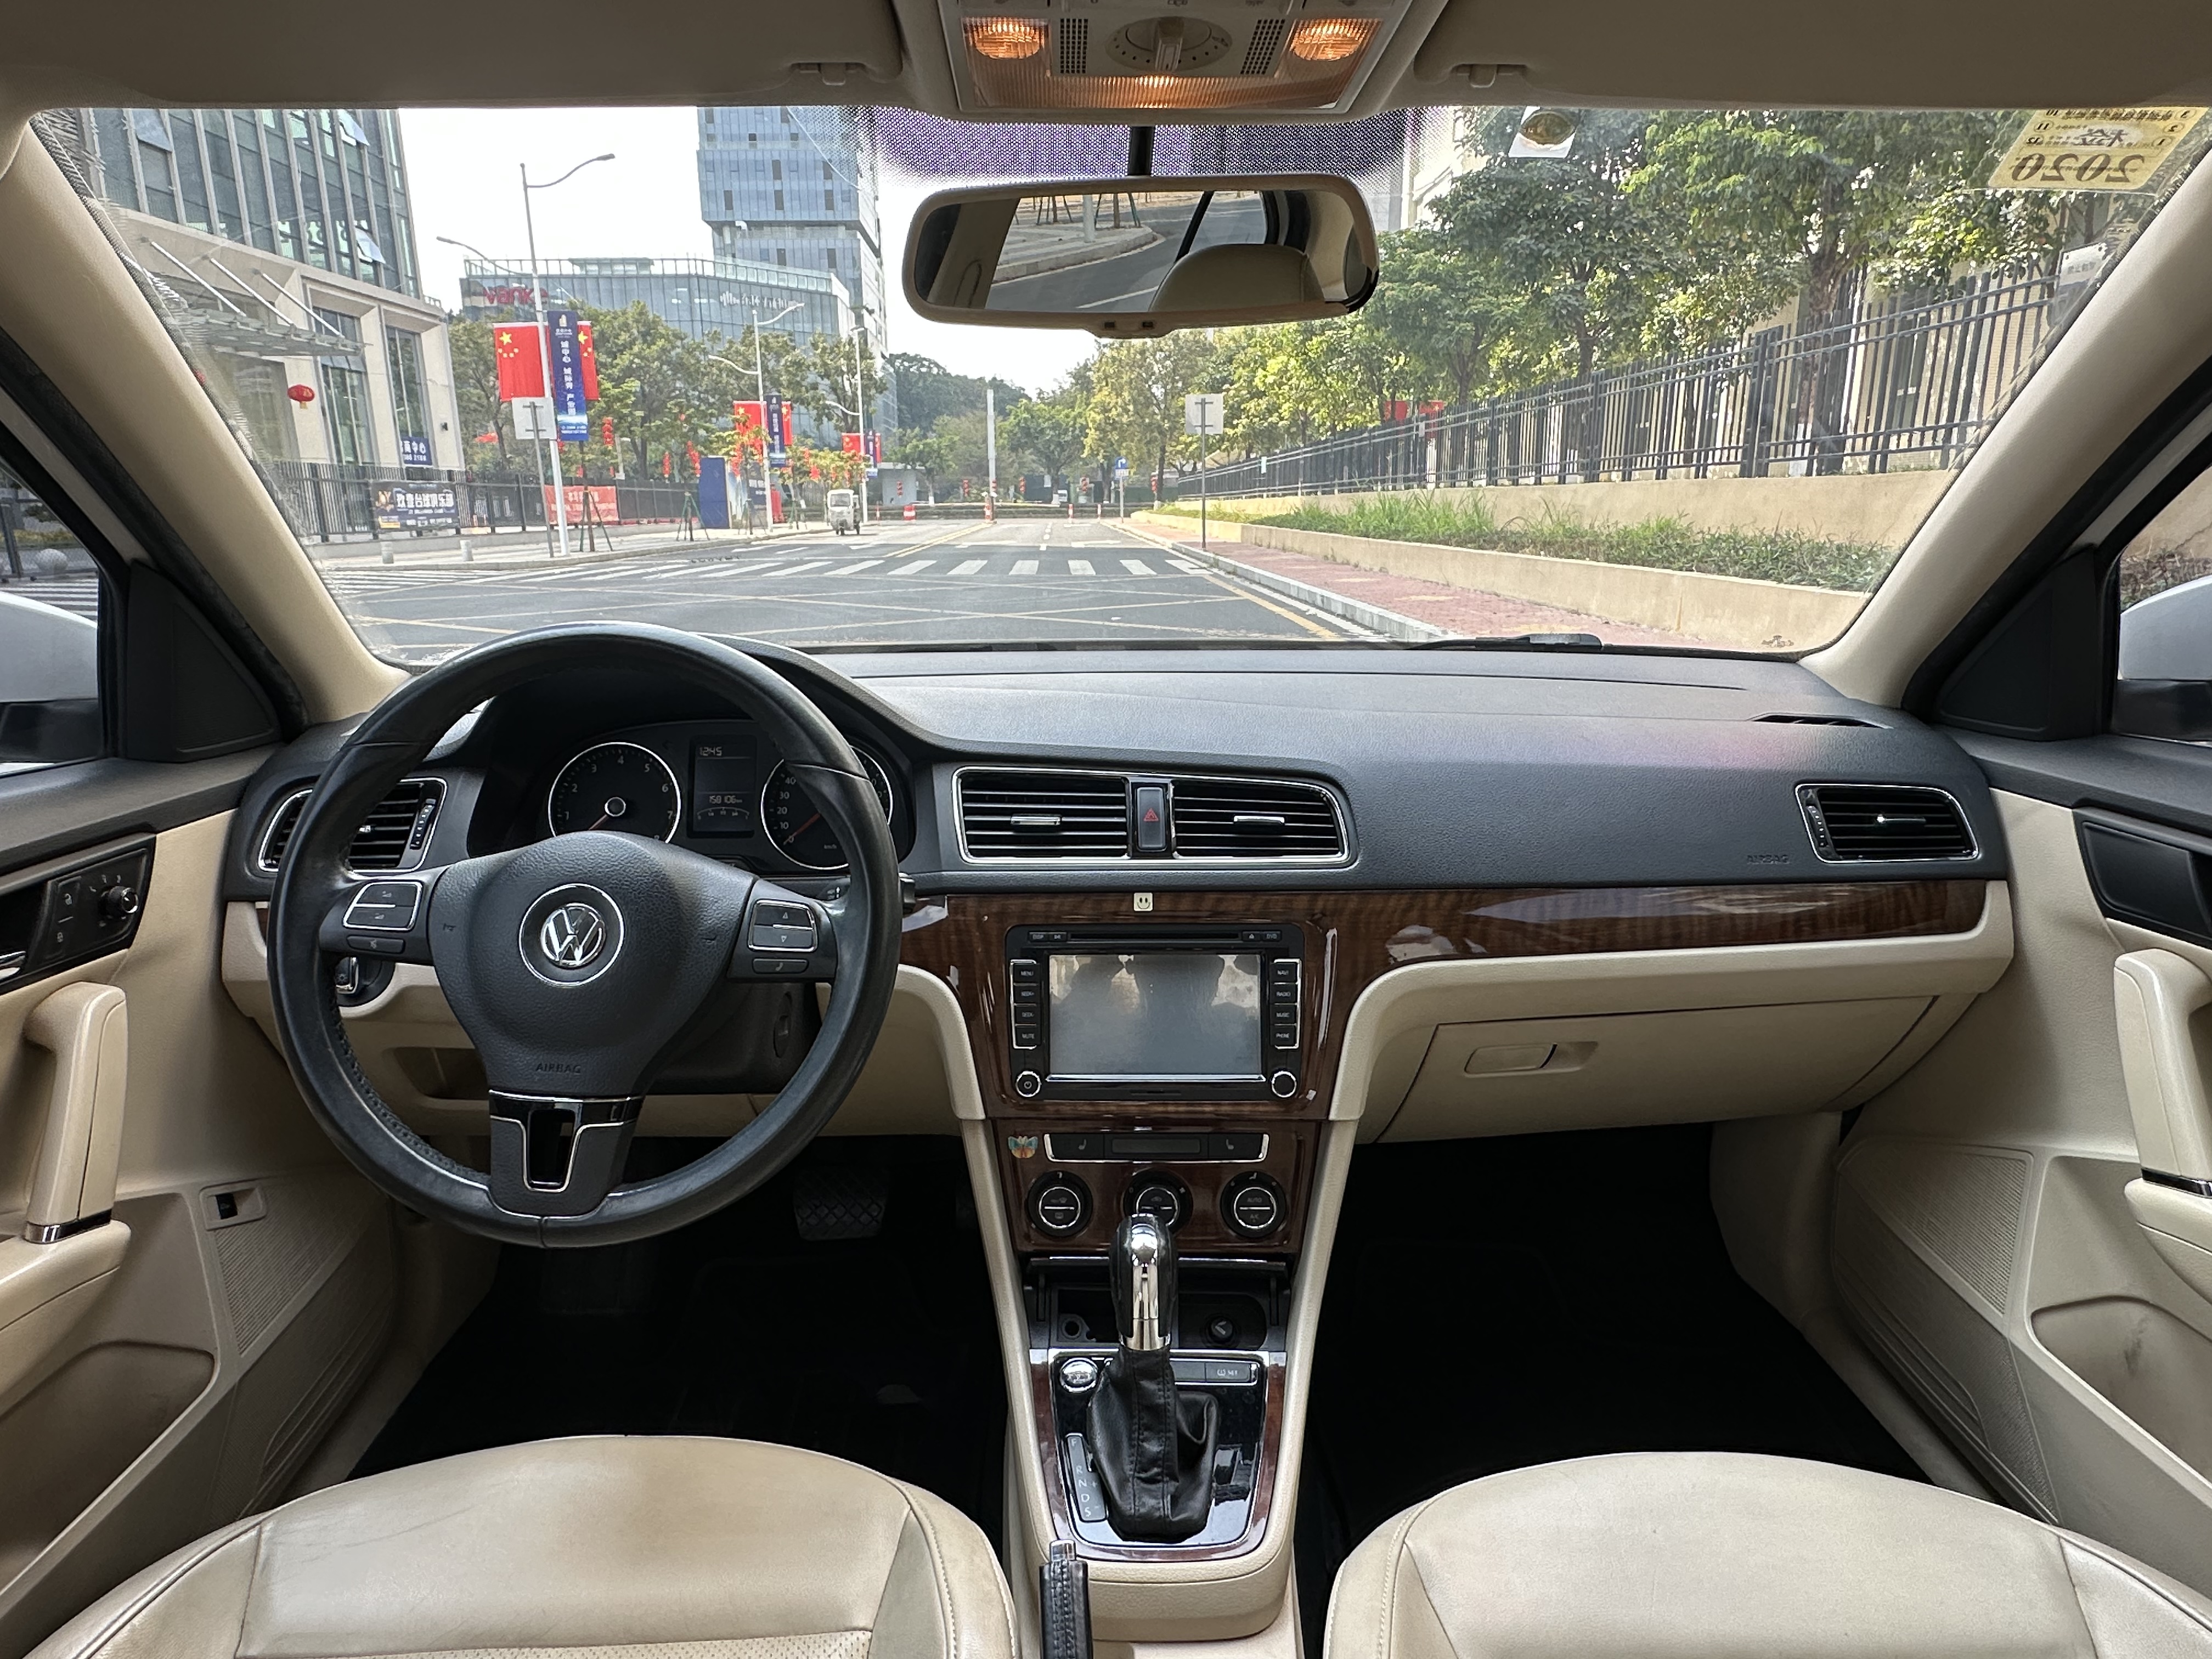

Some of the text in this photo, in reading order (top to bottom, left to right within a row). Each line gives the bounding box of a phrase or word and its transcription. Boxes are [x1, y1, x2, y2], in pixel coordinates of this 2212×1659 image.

[618, 755, 624, 764] 4
[591, 764, 597, 772] 3
[645, 764, 650, 772] 5
[662, 783, 668, 792] 6
[565, 811, 569, 820] 1
[668, 811, 673, 820] 7
[535, 1062, 582, 1074] AIRBAG
[1076, 1465, 1084, 1475] R
[1079, 1479, 1087, 1487] N
[1081, 1493, 1090, 1502] D
[1084, 1507, 1092, 1517] S
